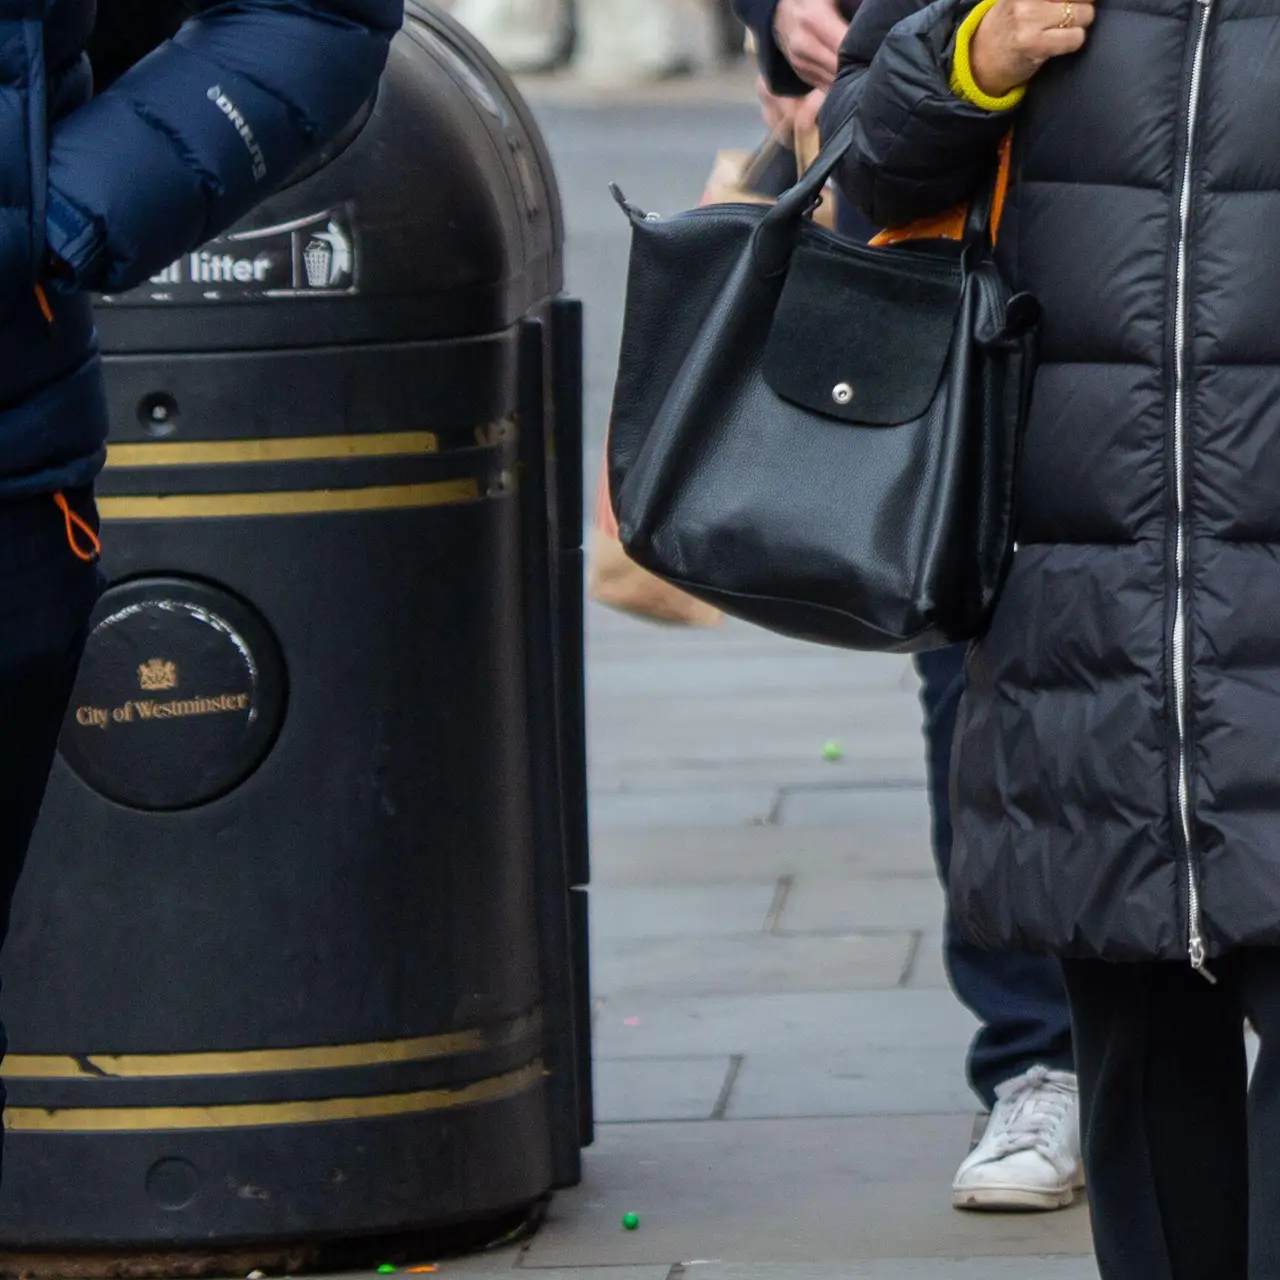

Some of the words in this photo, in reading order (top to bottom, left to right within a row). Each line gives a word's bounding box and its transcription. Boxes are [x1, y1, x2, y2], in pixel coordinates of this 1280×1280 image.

[189, 250, 272, 283] litter
[76, 705, 108, 730] City
[112, 700, 133, 722] of
[134, 692, 248, 719] Westminster
